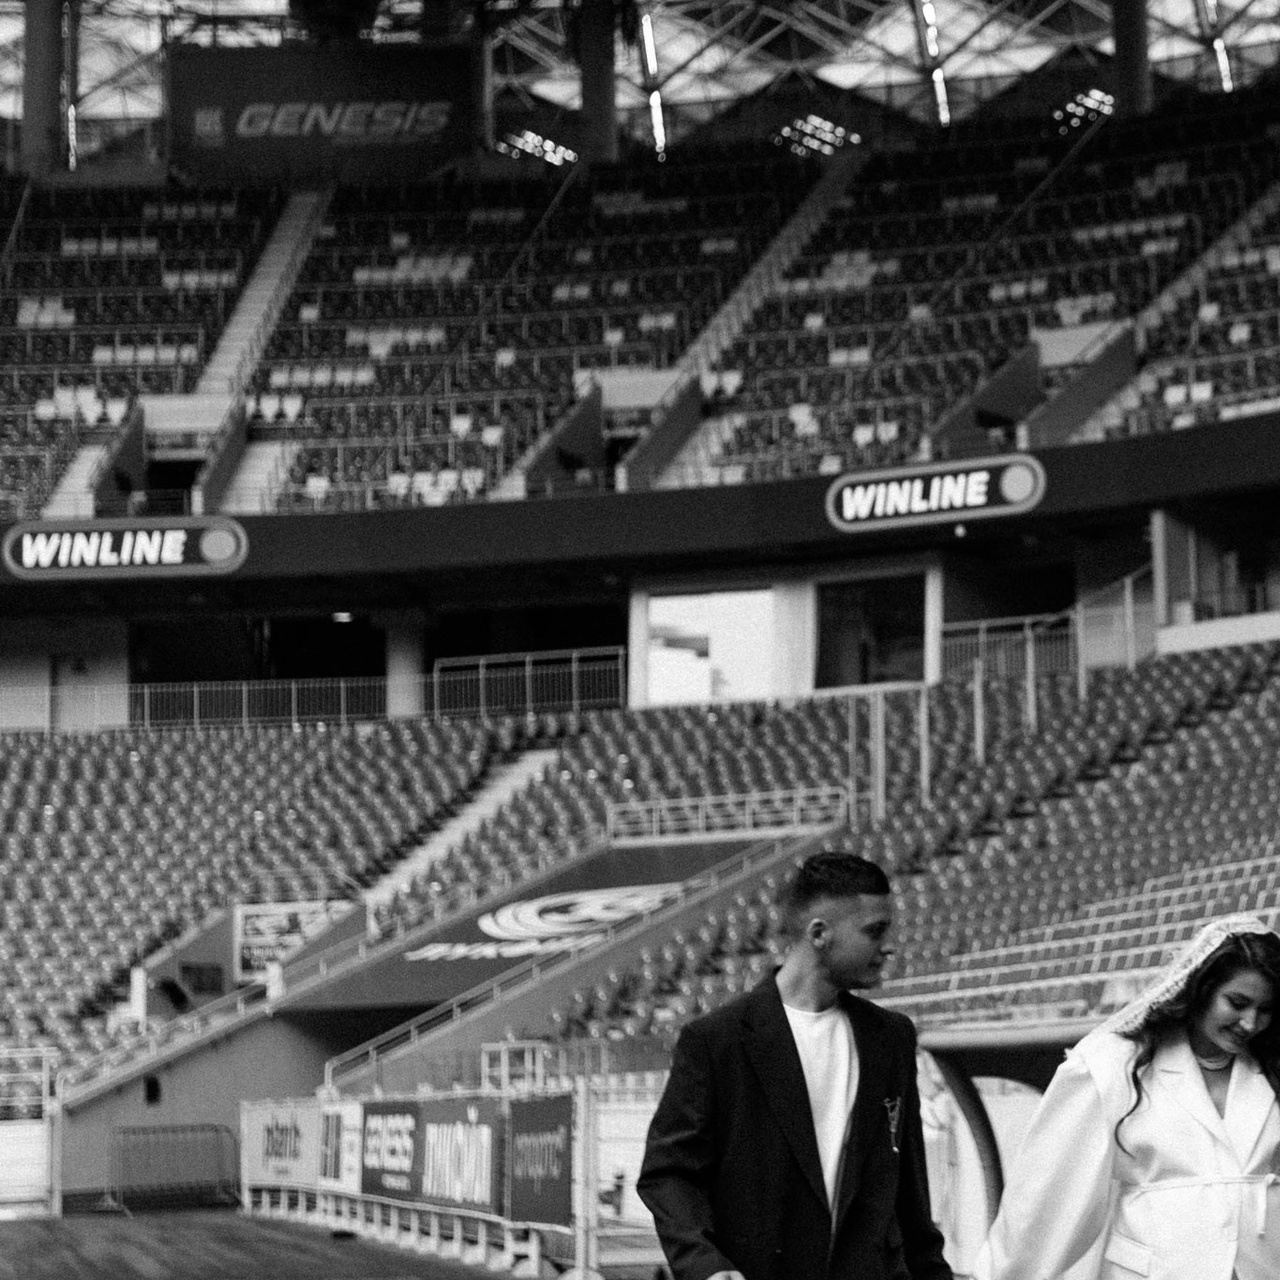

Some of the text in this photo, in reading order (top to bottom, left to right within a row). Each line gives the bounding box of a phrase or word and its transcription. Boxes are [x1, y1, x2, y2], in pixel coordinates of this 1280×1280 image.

[236, 102, 451, 136] GENESIS
[842, 471, 990, 521] WINLINE
[22, 530, 188, 568] WINLINE
